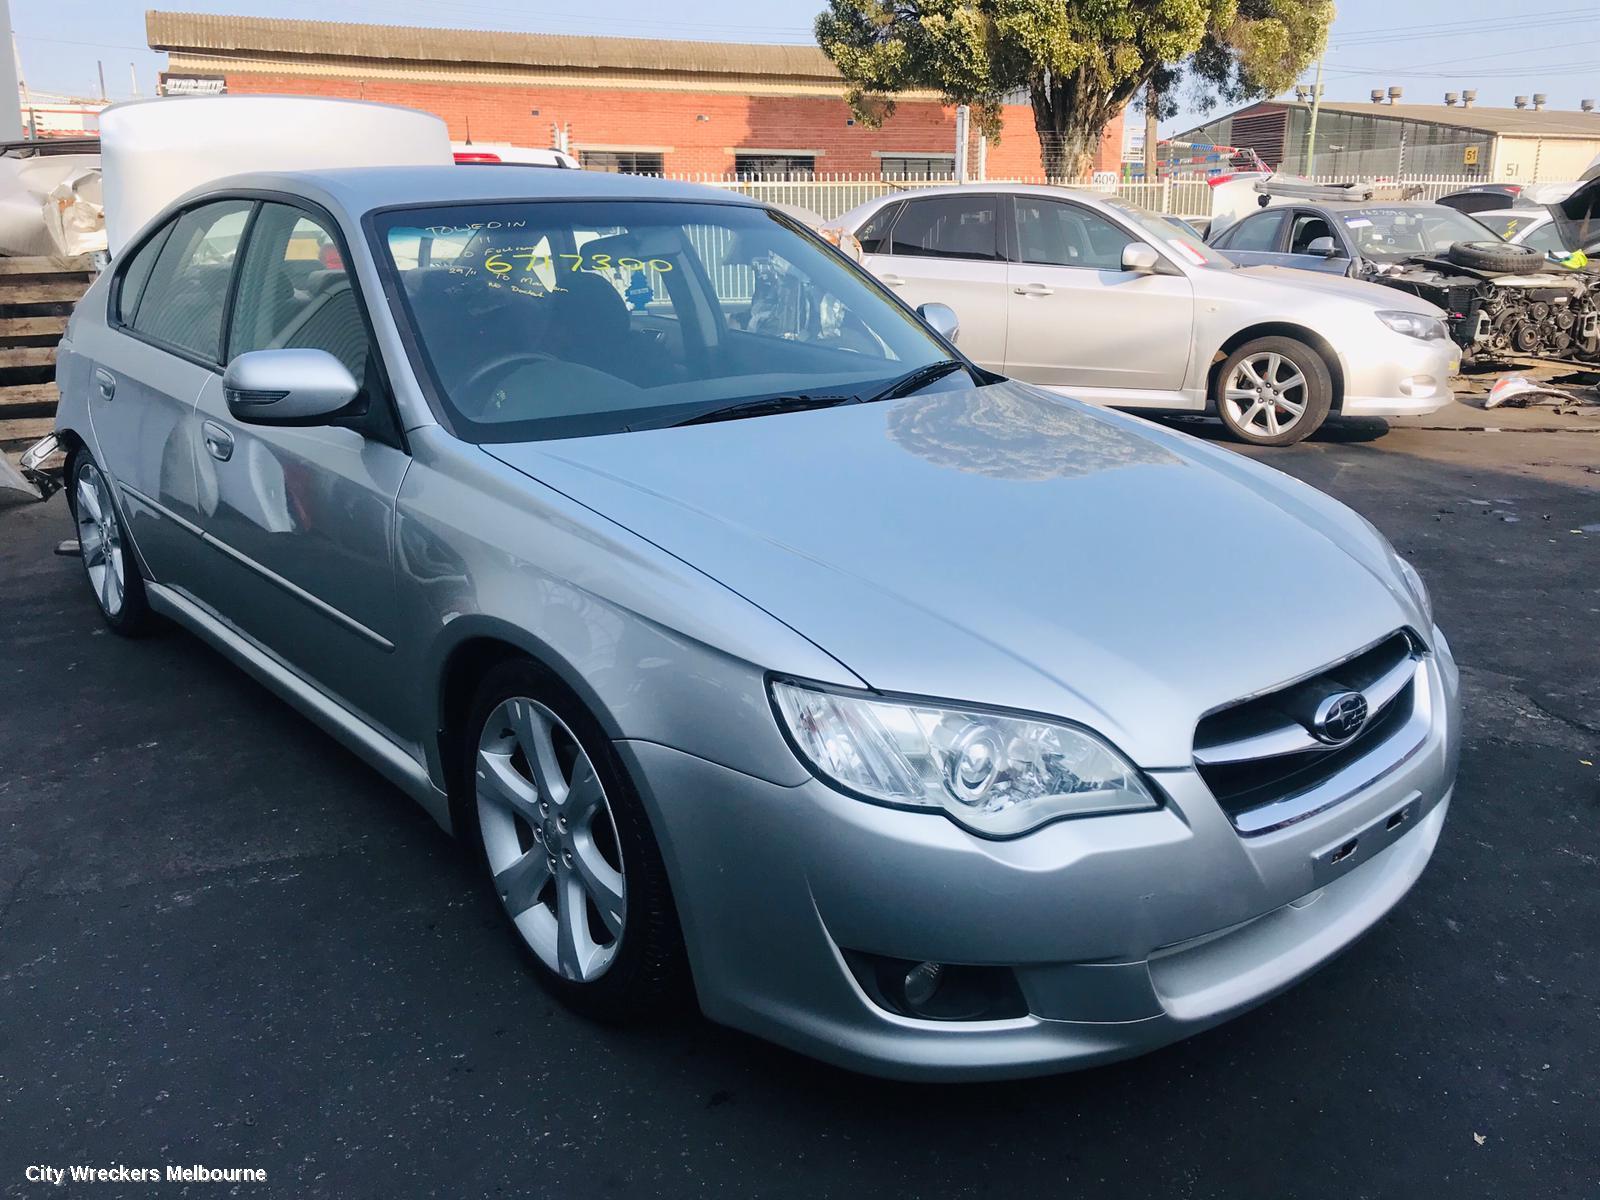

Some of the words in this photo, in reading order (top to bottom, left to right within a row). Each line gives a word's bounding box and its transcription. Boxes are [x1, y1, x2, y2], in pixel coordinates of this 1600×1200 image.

[1466, 150, 1477, 161] 51
[1506, 162, 1519, 176] 51
[1094, 173, 1116, 185] 409
[425, 221, 502, 238] TOWED
[507, 220, 526, 228] IN
[485, 253, 673, 274] 6717300
